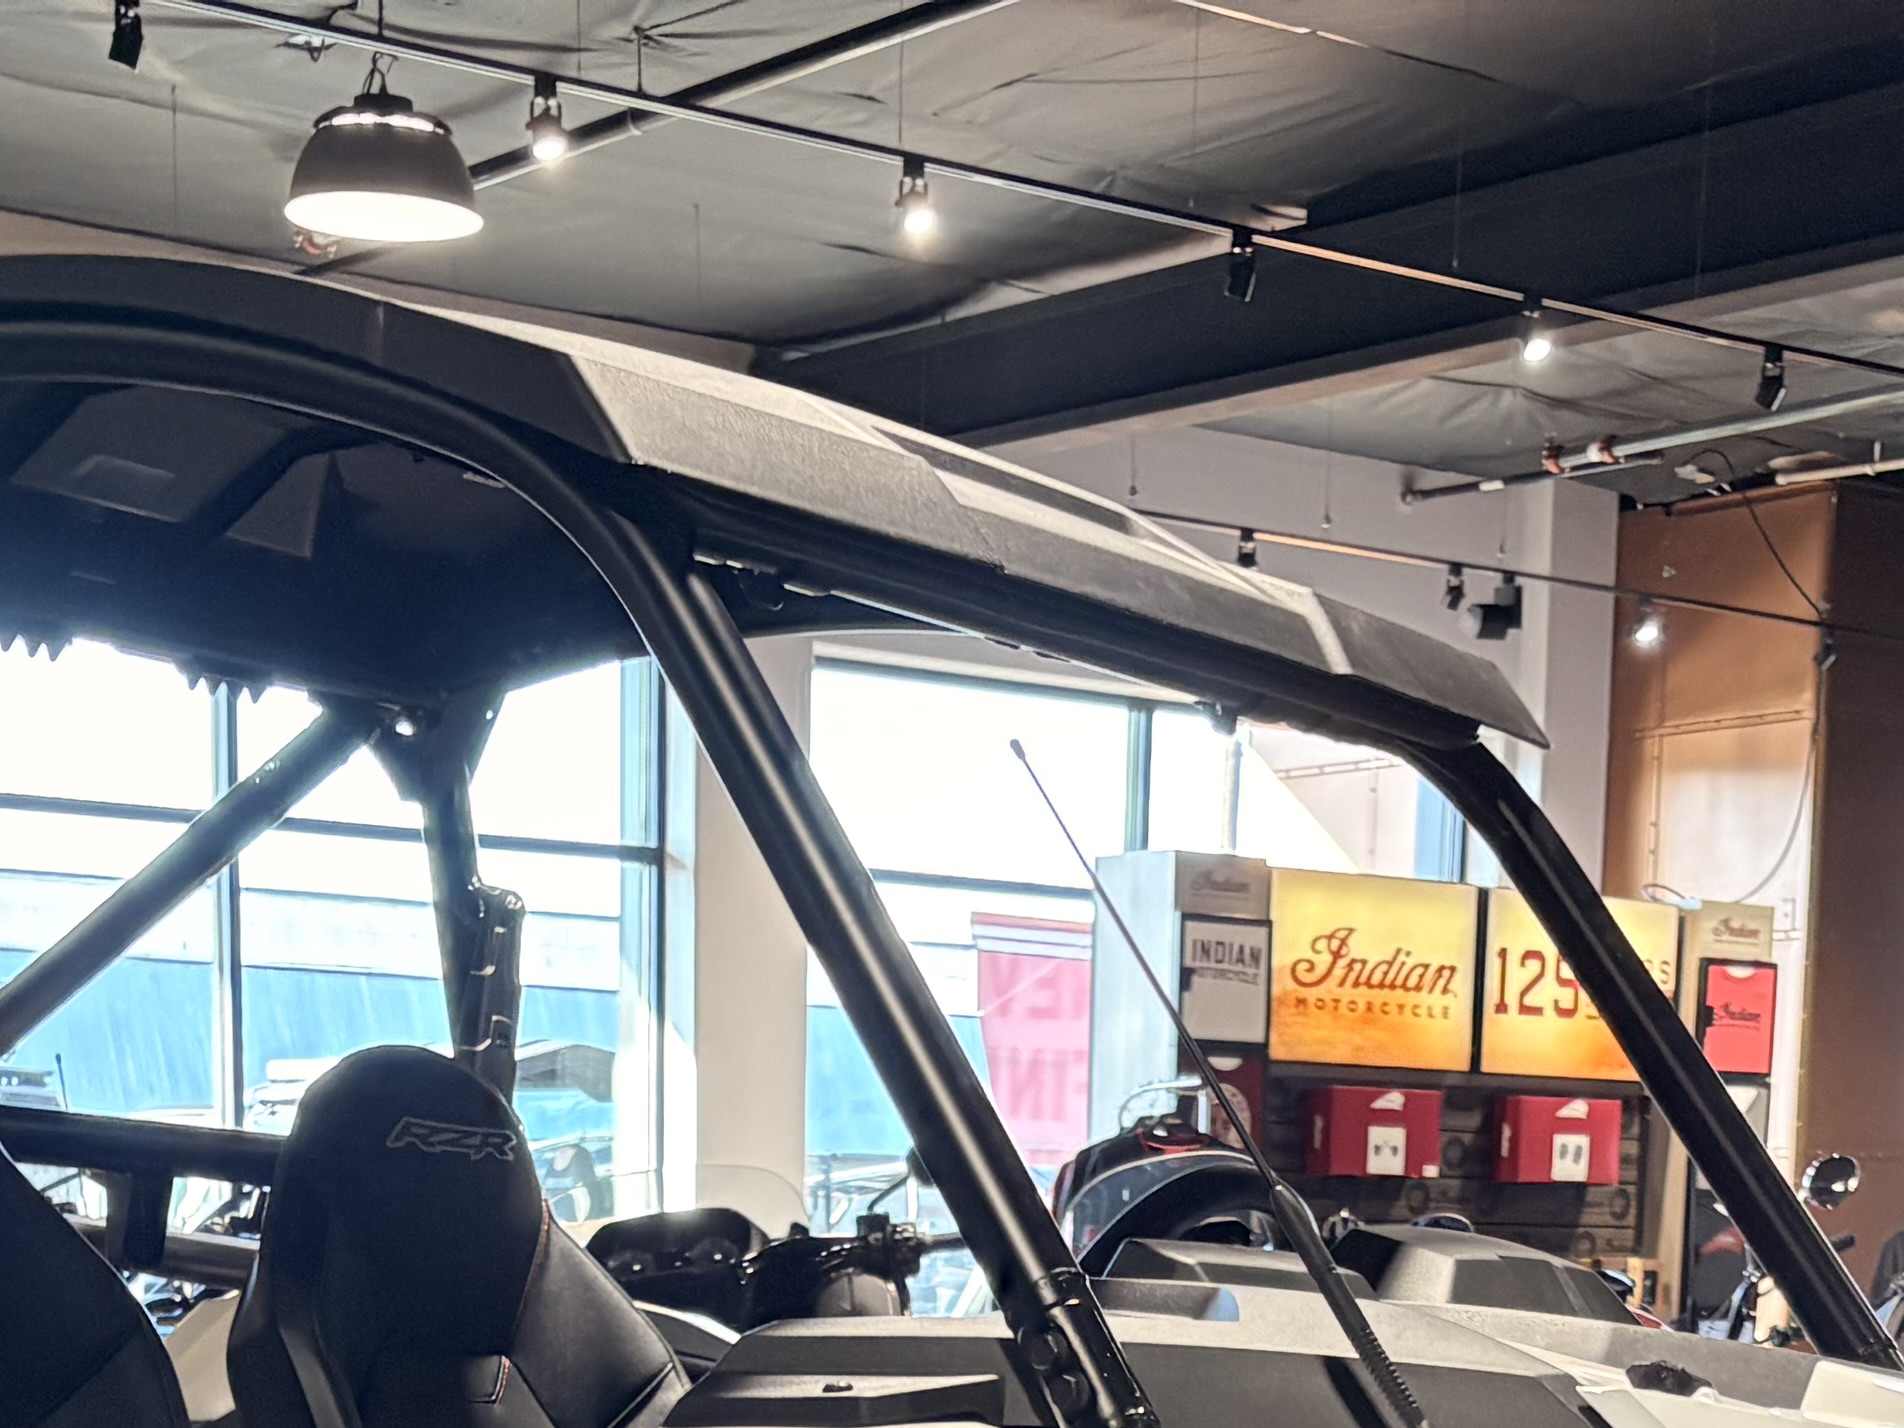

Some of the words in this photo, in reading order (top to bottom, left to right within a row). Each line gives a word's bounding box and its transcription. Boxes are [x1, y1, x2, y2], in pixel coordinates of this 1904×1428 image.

[1191, 938, 1263, 970] INDIAN
[1290, 926, 1458, 998] Indian
[1294, 996, 1451, 1021] MOTORCYCLE
[385, 1115, 518, 1162] RZR
